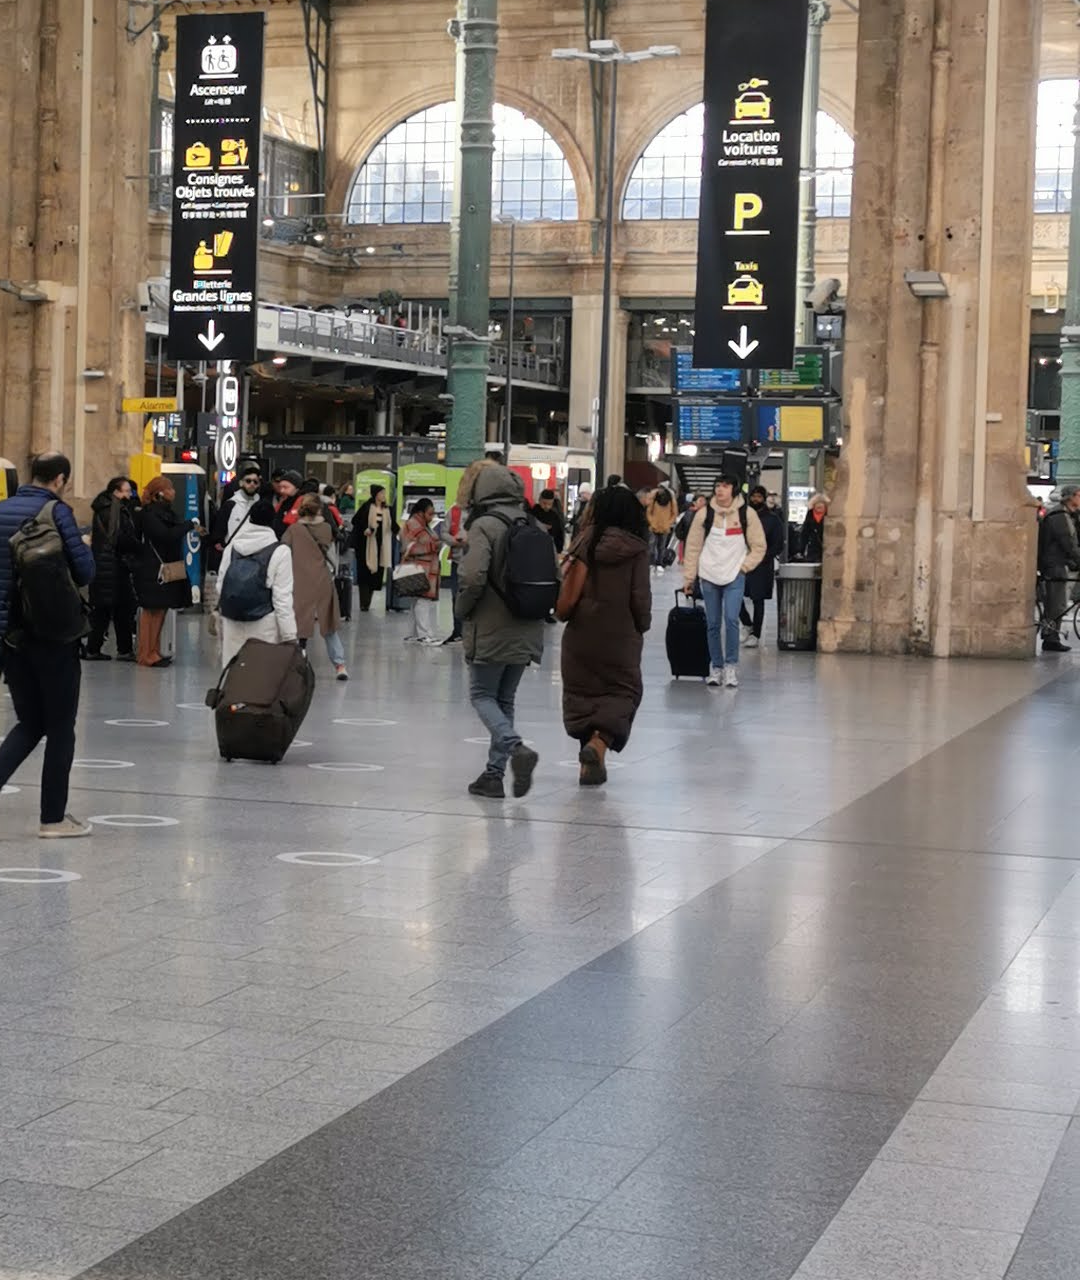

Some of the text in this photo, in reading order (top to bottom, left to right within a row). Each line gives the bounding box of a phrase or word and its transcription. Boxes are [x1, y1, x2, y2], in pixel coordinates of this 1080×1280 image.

[190, 84, 247, 96] Ascenseur
[723, 129, 780, 143] Location
[724, 143, 778, 156] voitures
[187, 173, 244, 187] Consignes
[176, 184, 256, 200] Objets trouvés
[734, 193, 763, 229] P
[734, 261, 758, 271] Taxis
[172, 289, 253, 304] Grandes lignes
[140, 402, 174, 410] Alarme
